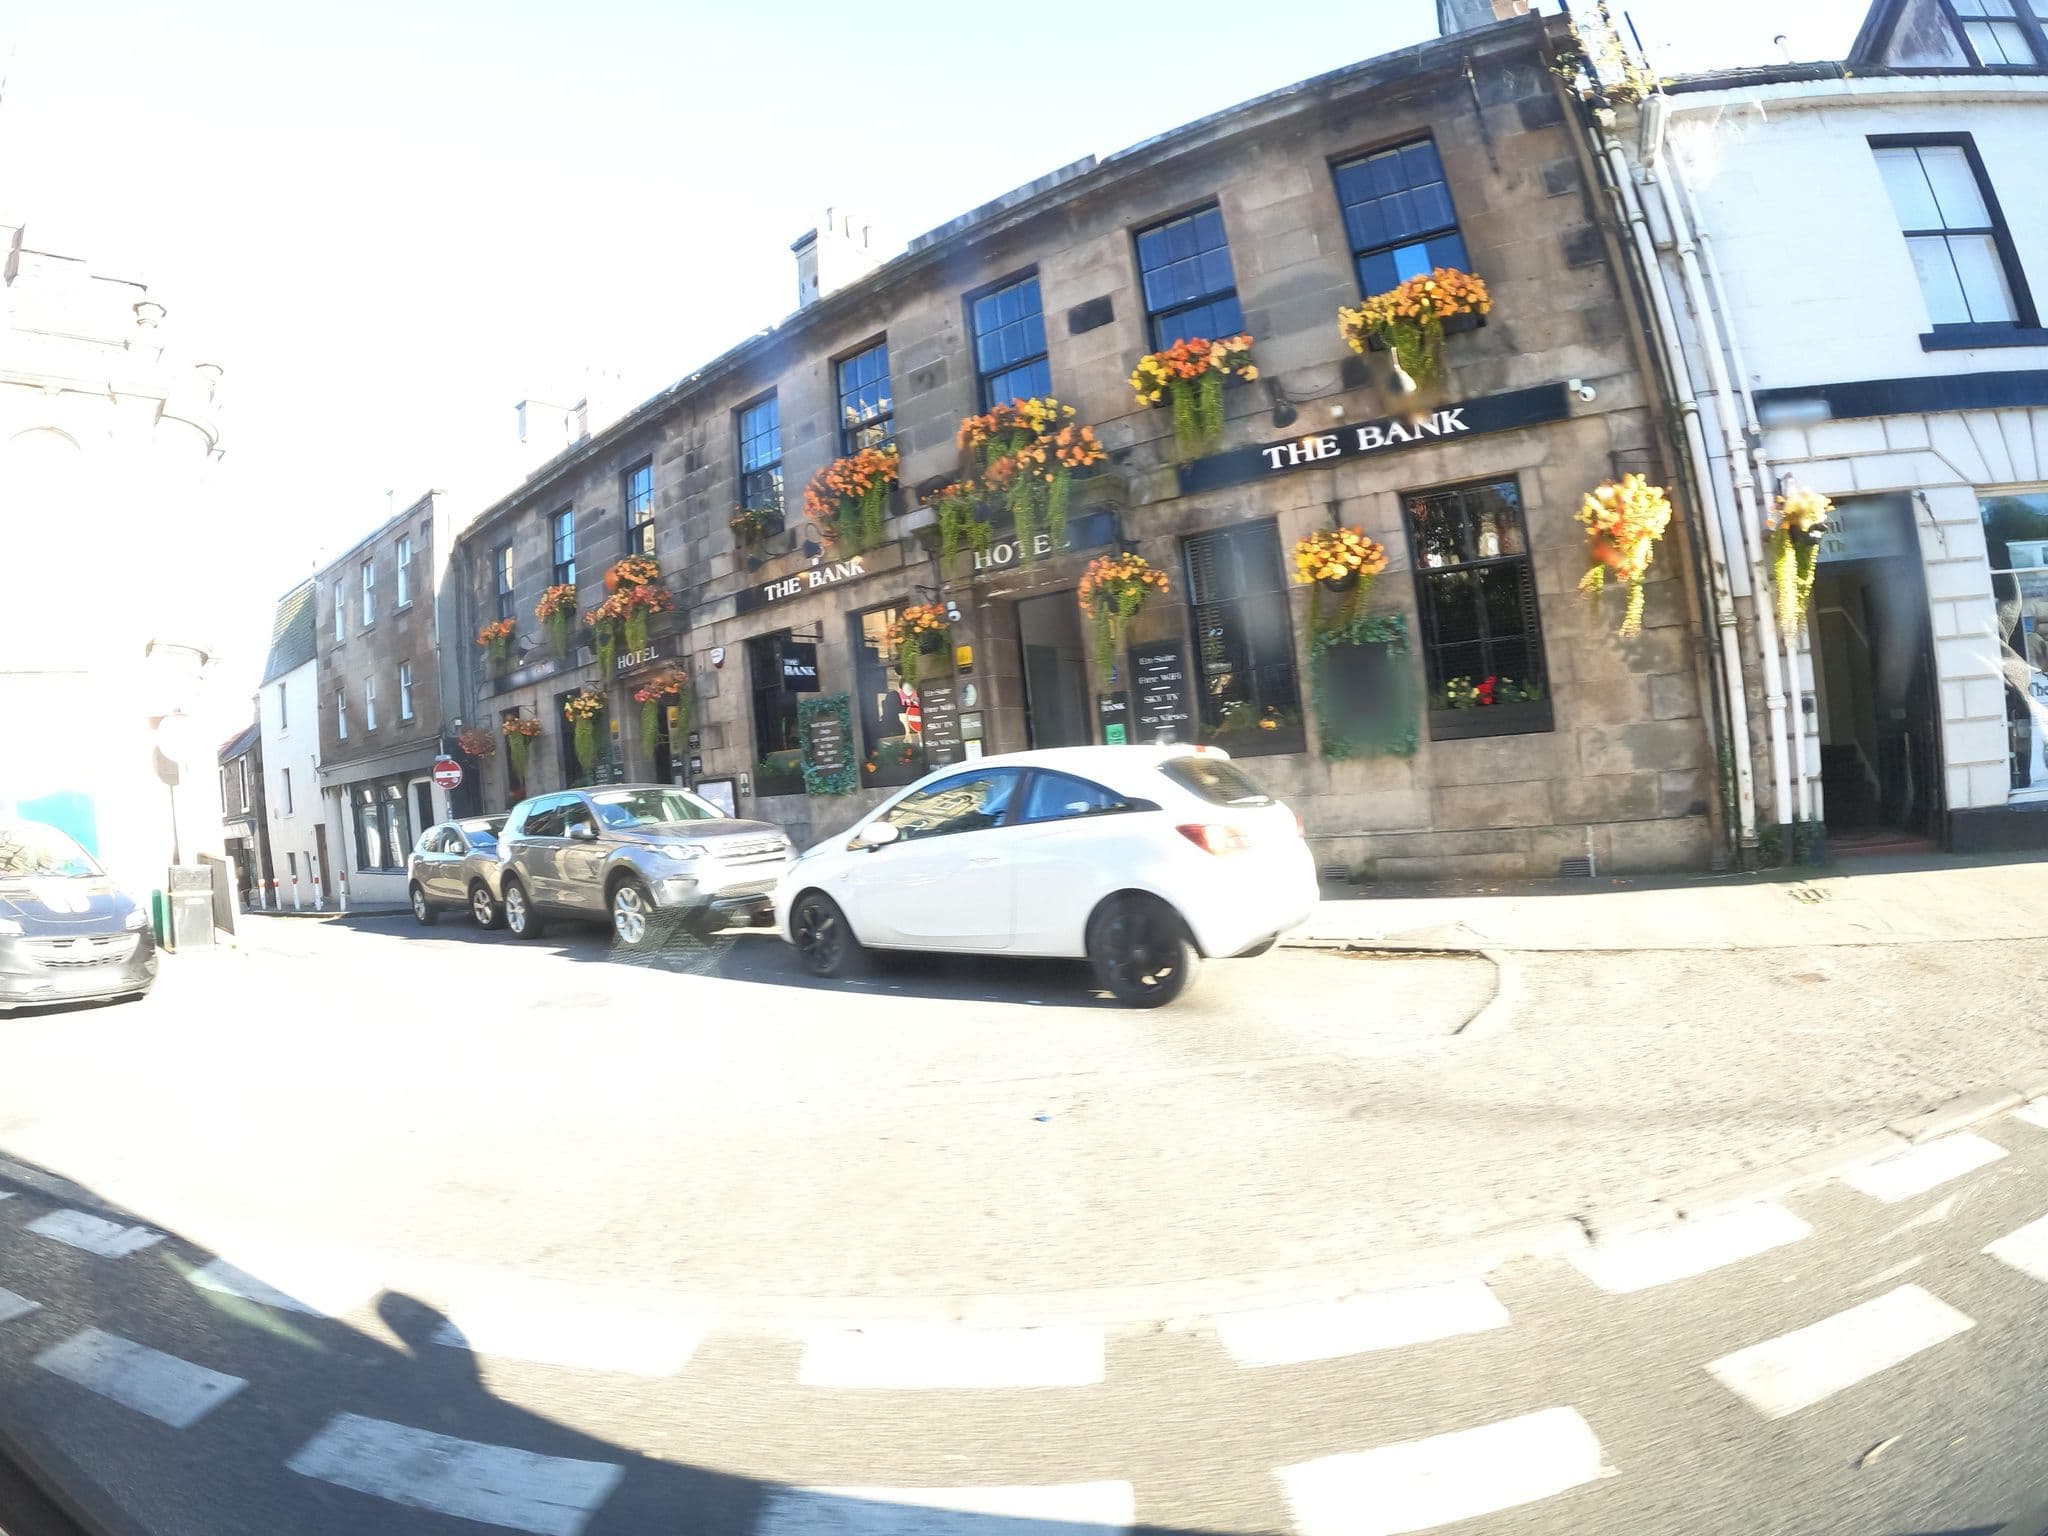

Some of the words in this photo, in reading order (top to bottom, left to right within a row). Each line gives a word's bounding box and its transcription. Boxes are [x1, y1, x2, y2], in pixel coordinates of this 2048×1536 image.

[1262, 434, 1342, 470] THE
[1356, 407, 1471, 452] BANK
[764, 577, 802, 601] THE
[808, 558, 865, 589] BANK
[617, 646, 659, 669] HOTEL
[783, 665, 817, 676] BANK
